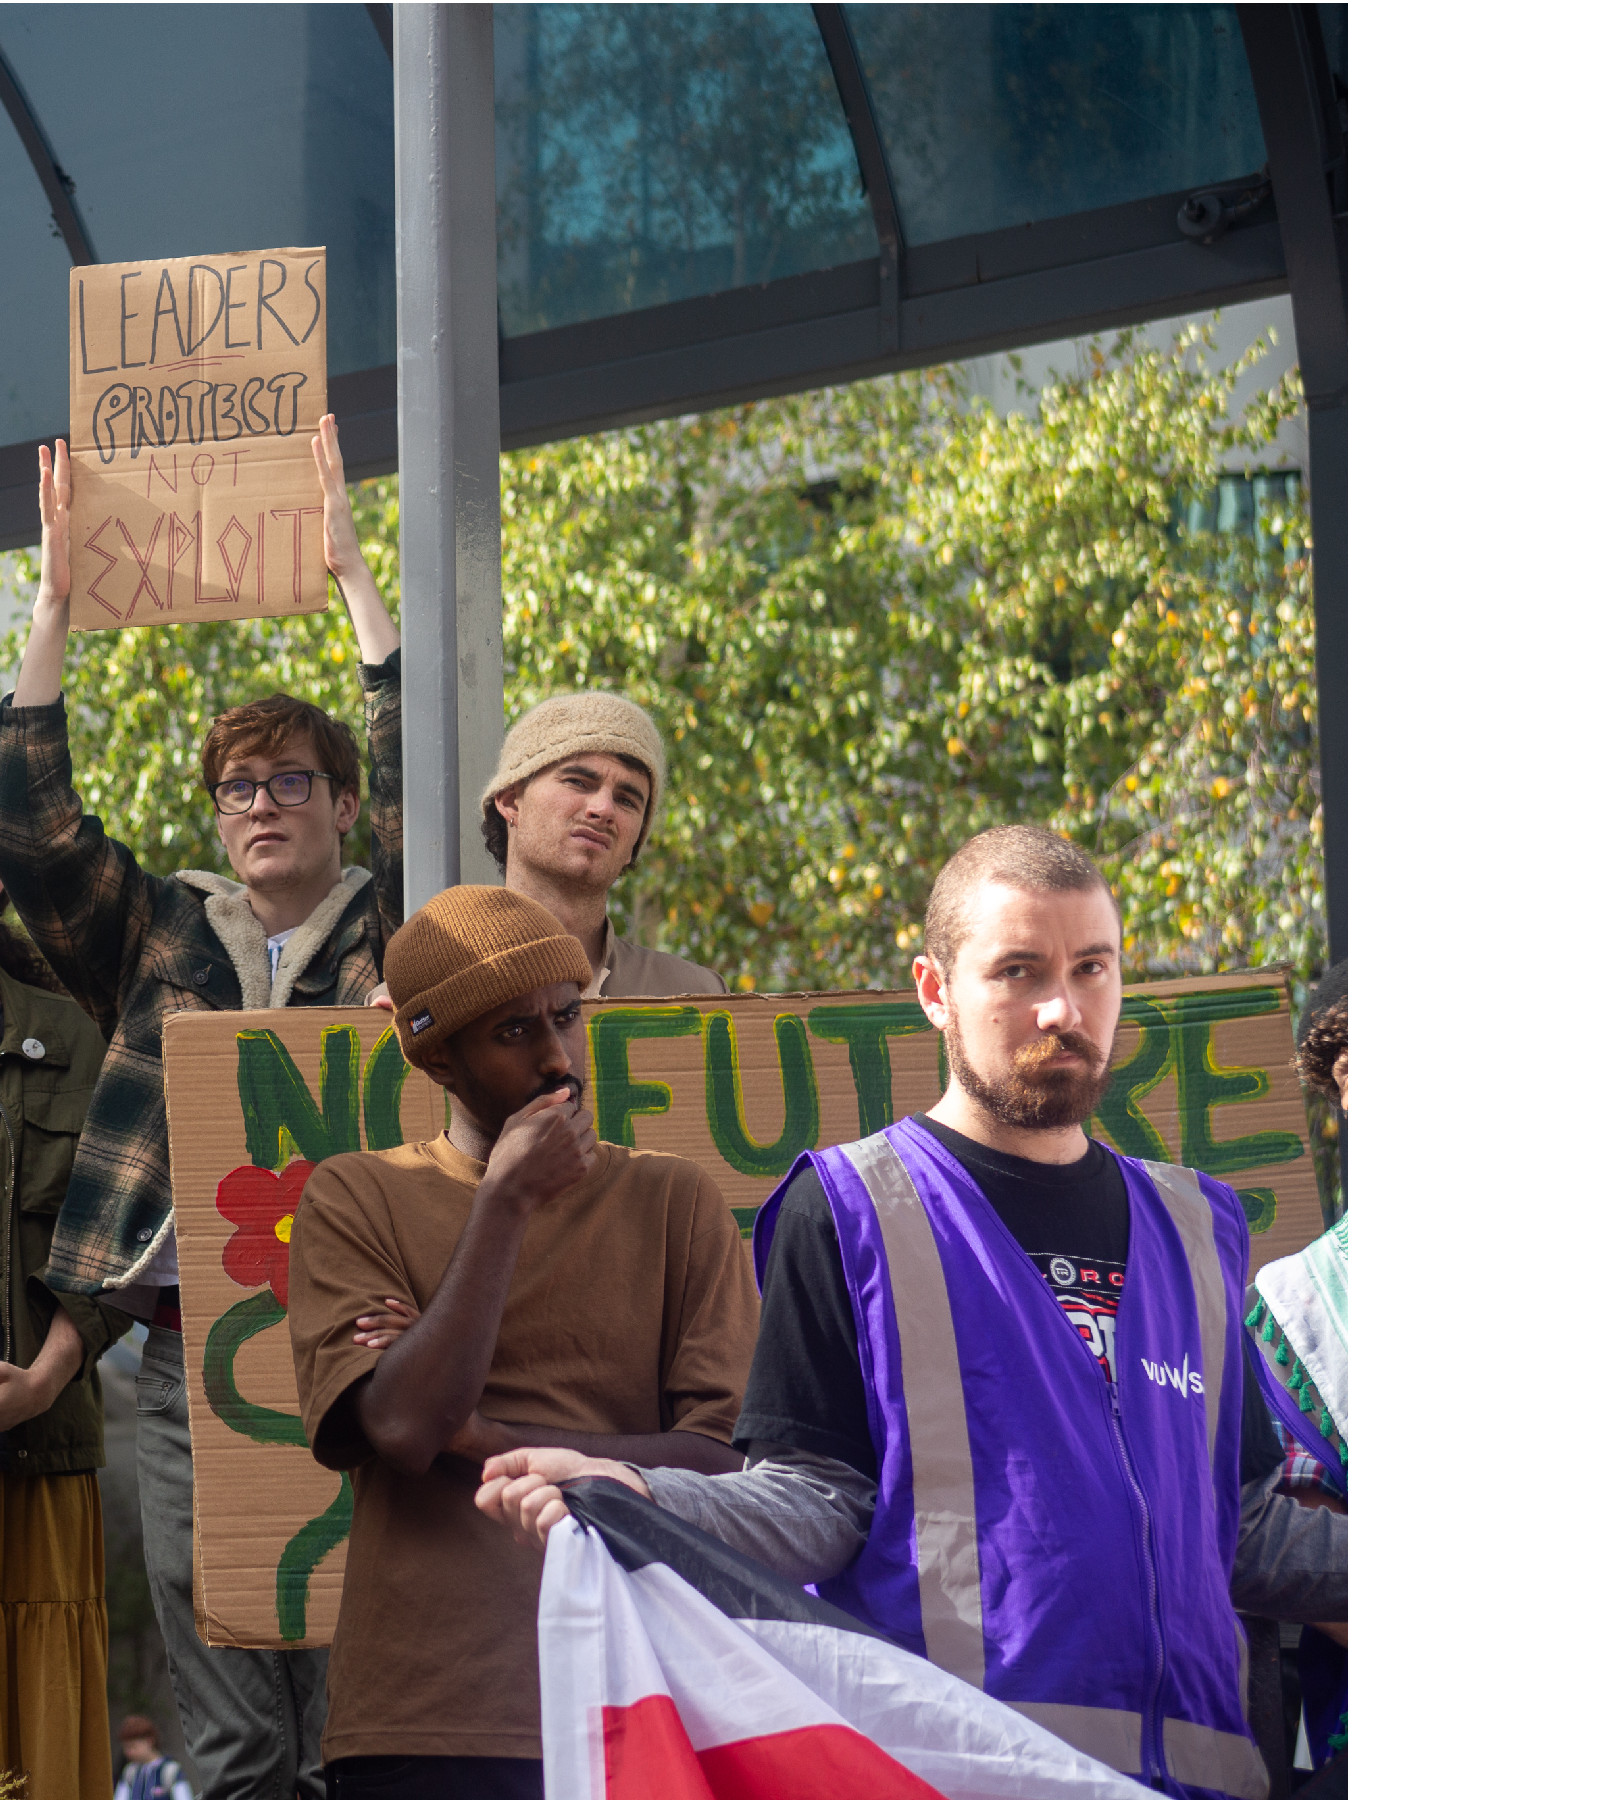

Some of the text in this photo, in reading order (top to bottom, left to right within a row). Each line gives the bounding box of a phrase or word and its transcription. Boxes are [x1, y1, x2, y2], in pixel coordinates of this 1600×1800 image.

[79, 259, 321, 375] LEADERS
[92, 372, 307, 464] PROTECT
[147, 449, 251, 498] NOT
[84, 506, 325, 621] EXPLOIT
[588, 986, 1305, 1179] FUTRE
[1141, 1352, 1204, 1398] VUWS
